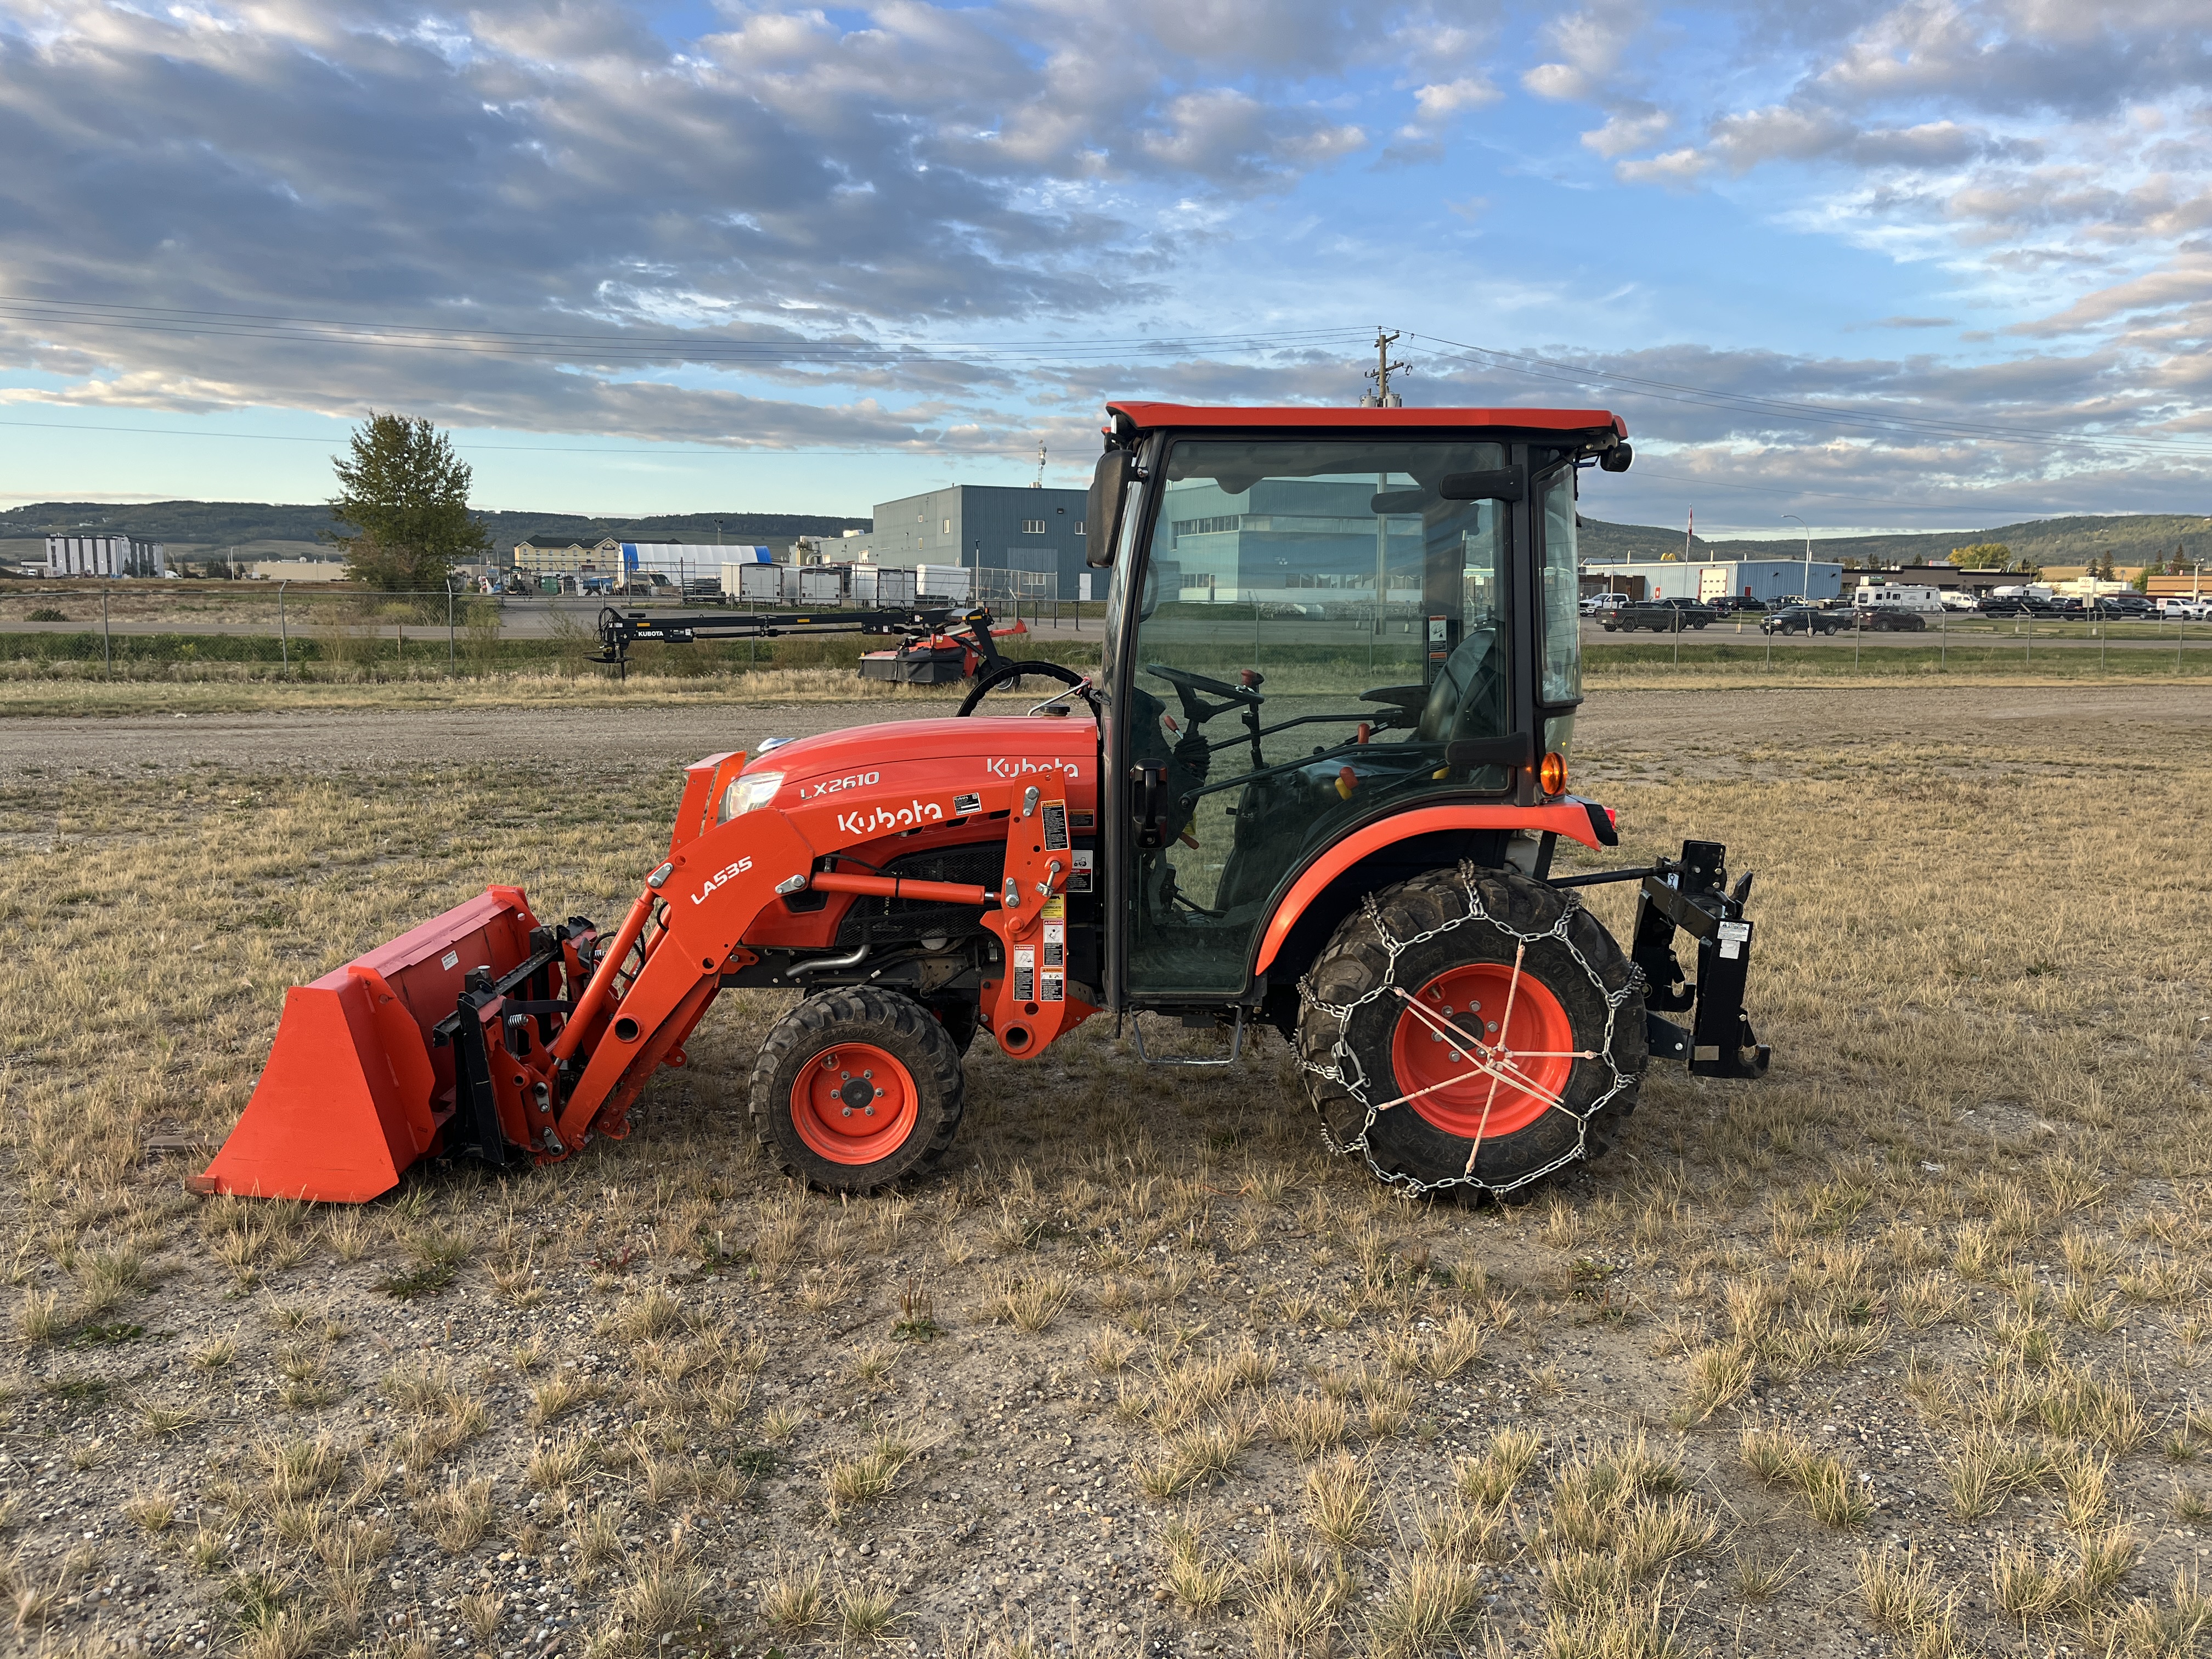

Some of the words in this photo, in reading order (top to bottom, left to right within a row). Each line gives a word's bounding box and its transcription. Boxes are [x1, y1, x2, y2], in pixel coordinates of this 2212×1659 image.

[800, 771, 880, 800] LX2610
[837, 799, 943, 834] Kubota
[690, 855, 753, 905] LA535
